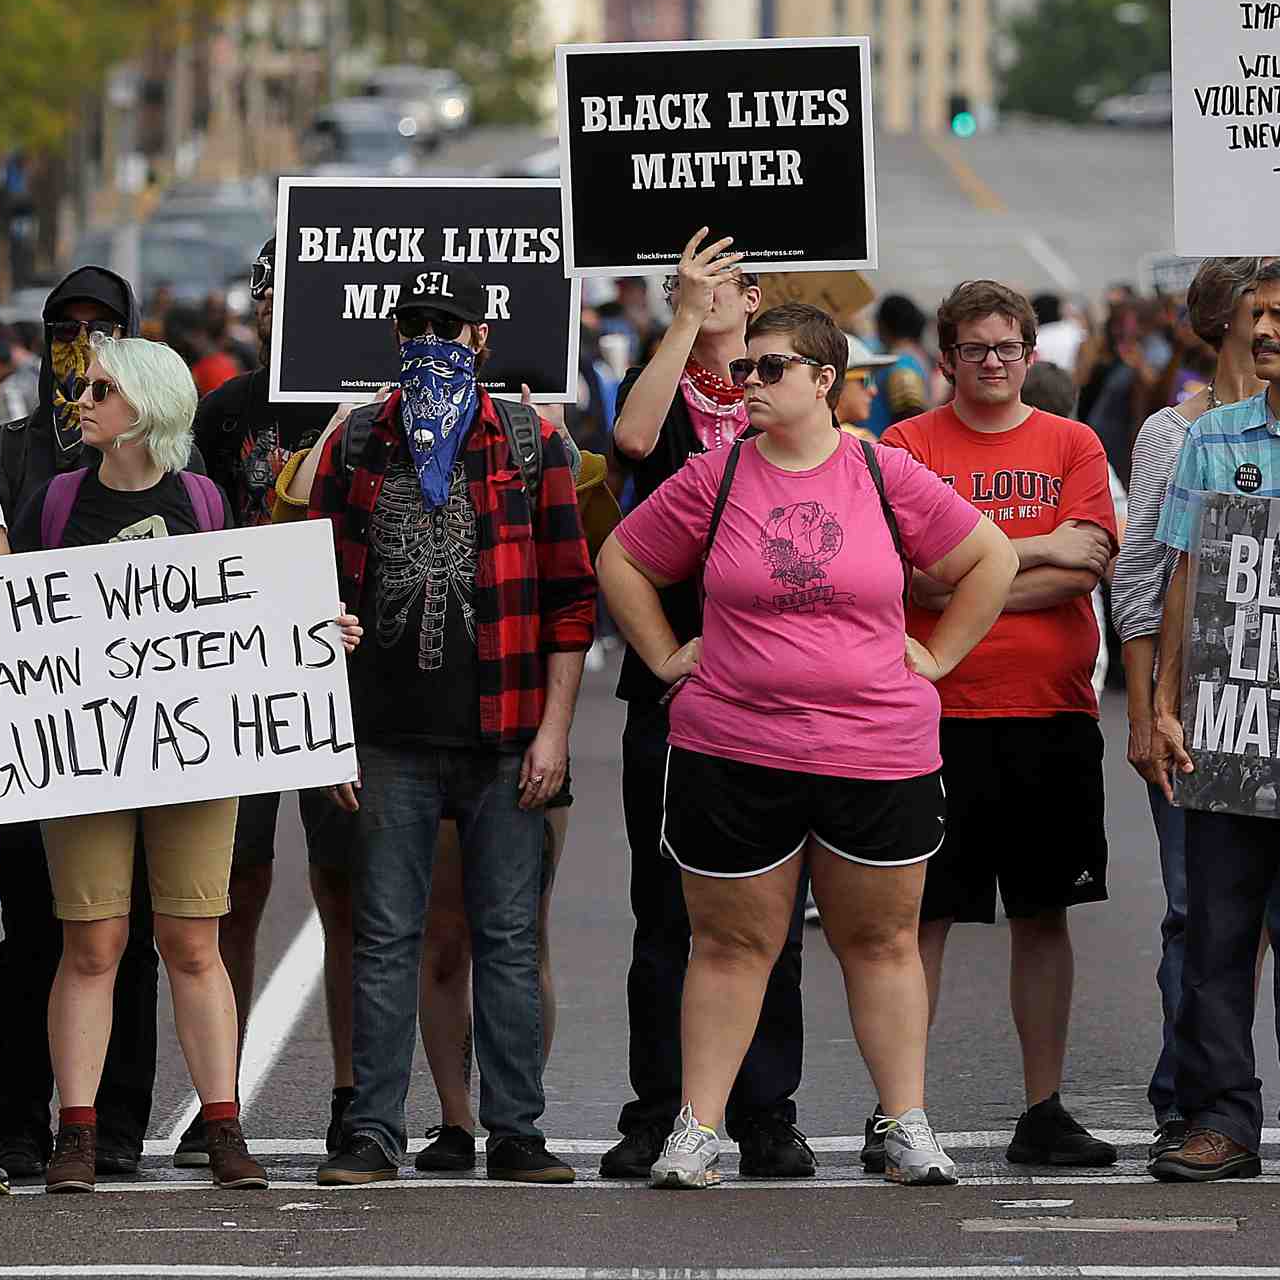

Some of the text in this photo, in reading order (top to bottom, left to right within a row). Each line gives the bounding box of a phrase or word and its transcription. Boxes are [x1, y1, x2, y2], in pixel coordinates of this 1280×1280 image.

[581, 89, 850, 132] BLACK LIVES
[631, 150, 803, 189] MATTER
[298, 227, 561, 263] BLACK LIVES
[342, 284, 511, 320] MAR
[413, 271, 454, 297] STL
[971, 470, 1063, 508] LOUIS
[999, 507, 1014, 521] THE
[1018, 506, 1042, 519] WEST
[94, 556, 258, 620] WHOLE
[105, 625, 268, 679] SYSTEM
[293, 620, 338, 668] IS
[153, 697, 210, 771] AS
[231, 691, 355, 761] HELL
